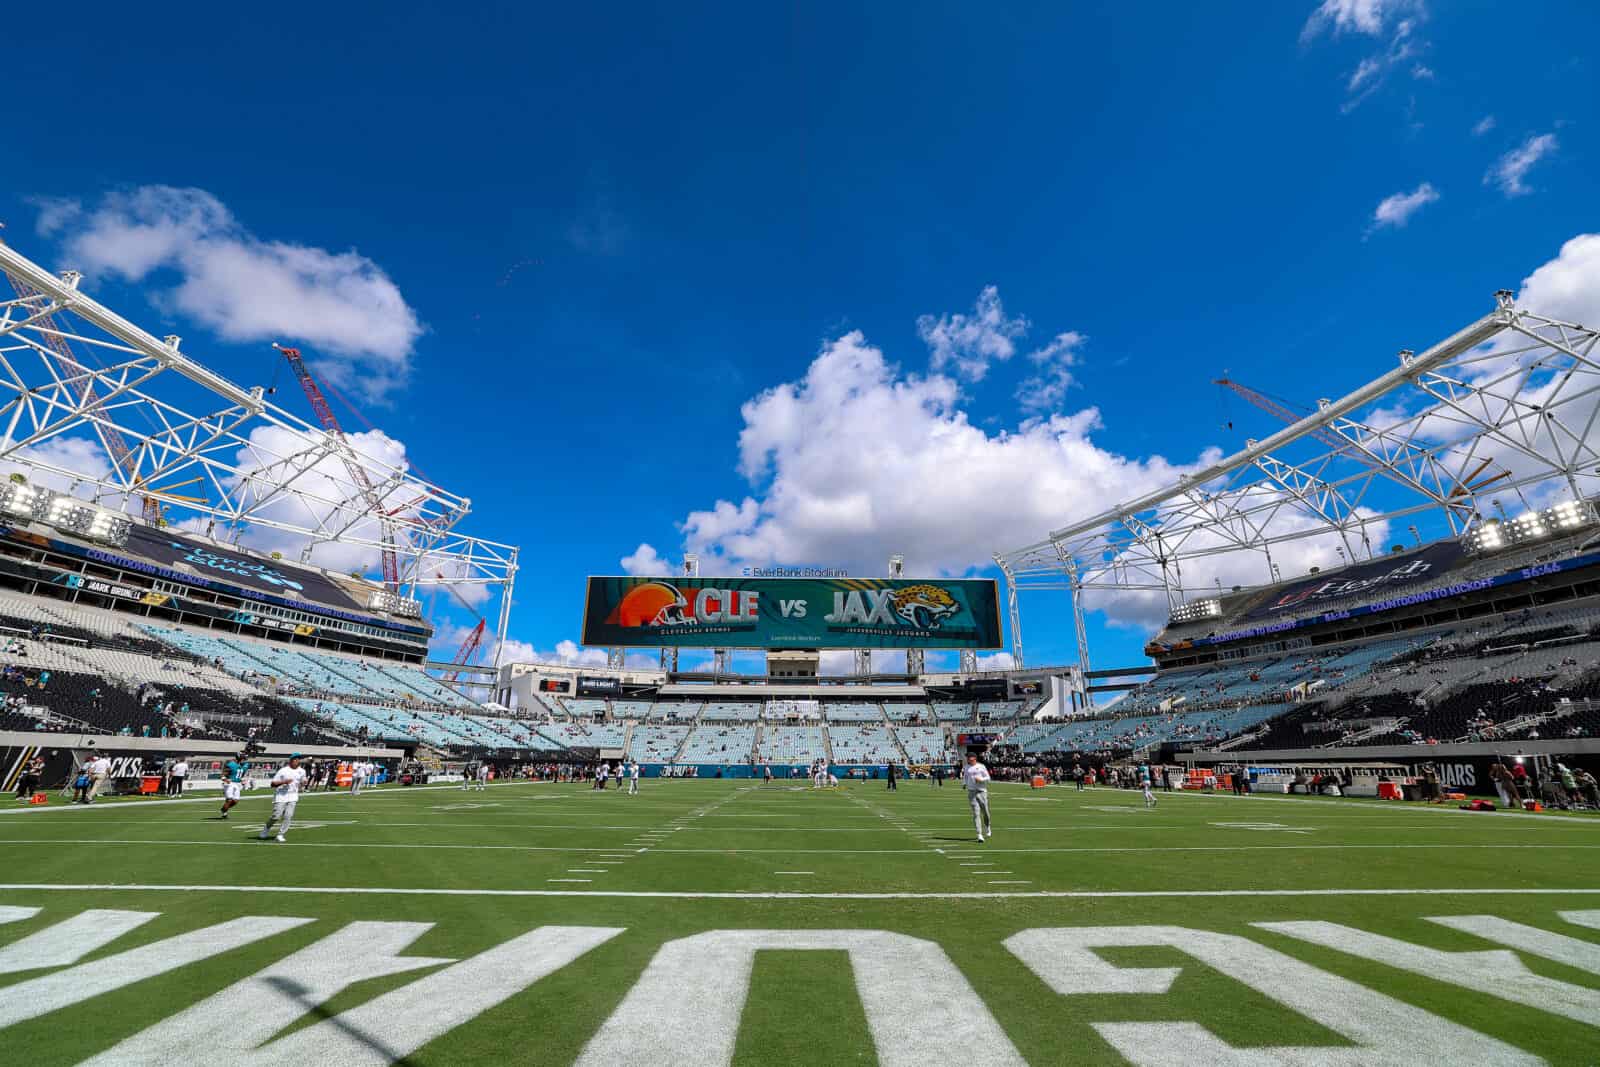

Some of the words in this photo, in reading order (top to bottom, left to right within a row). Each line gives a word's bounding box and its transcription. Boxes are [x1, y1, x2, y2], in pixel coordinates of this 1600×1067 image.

[86, 549, 156, 574] COUNTDOWN
[158, 566, 171, 578] TO
[170, 568, 211, 587] KICKOFF
[753, 567, 802, 577] EverBank
[804, 567, 848, 577] Stadium
[87, 580, 110, 594] MARK
[1370, 590, 1433, 612] COUNTDOWN
[1432, 587, 1448, 600] TO
[1448, 577, 1495, 596] KICKOFF
[695, 587, 760, 624] CLE
[823, 588, 897, 624] JAX
[1209, 628, 1257, 644] COUNTDOWN
[1265, 620, 1297, 633] KICKOFF
